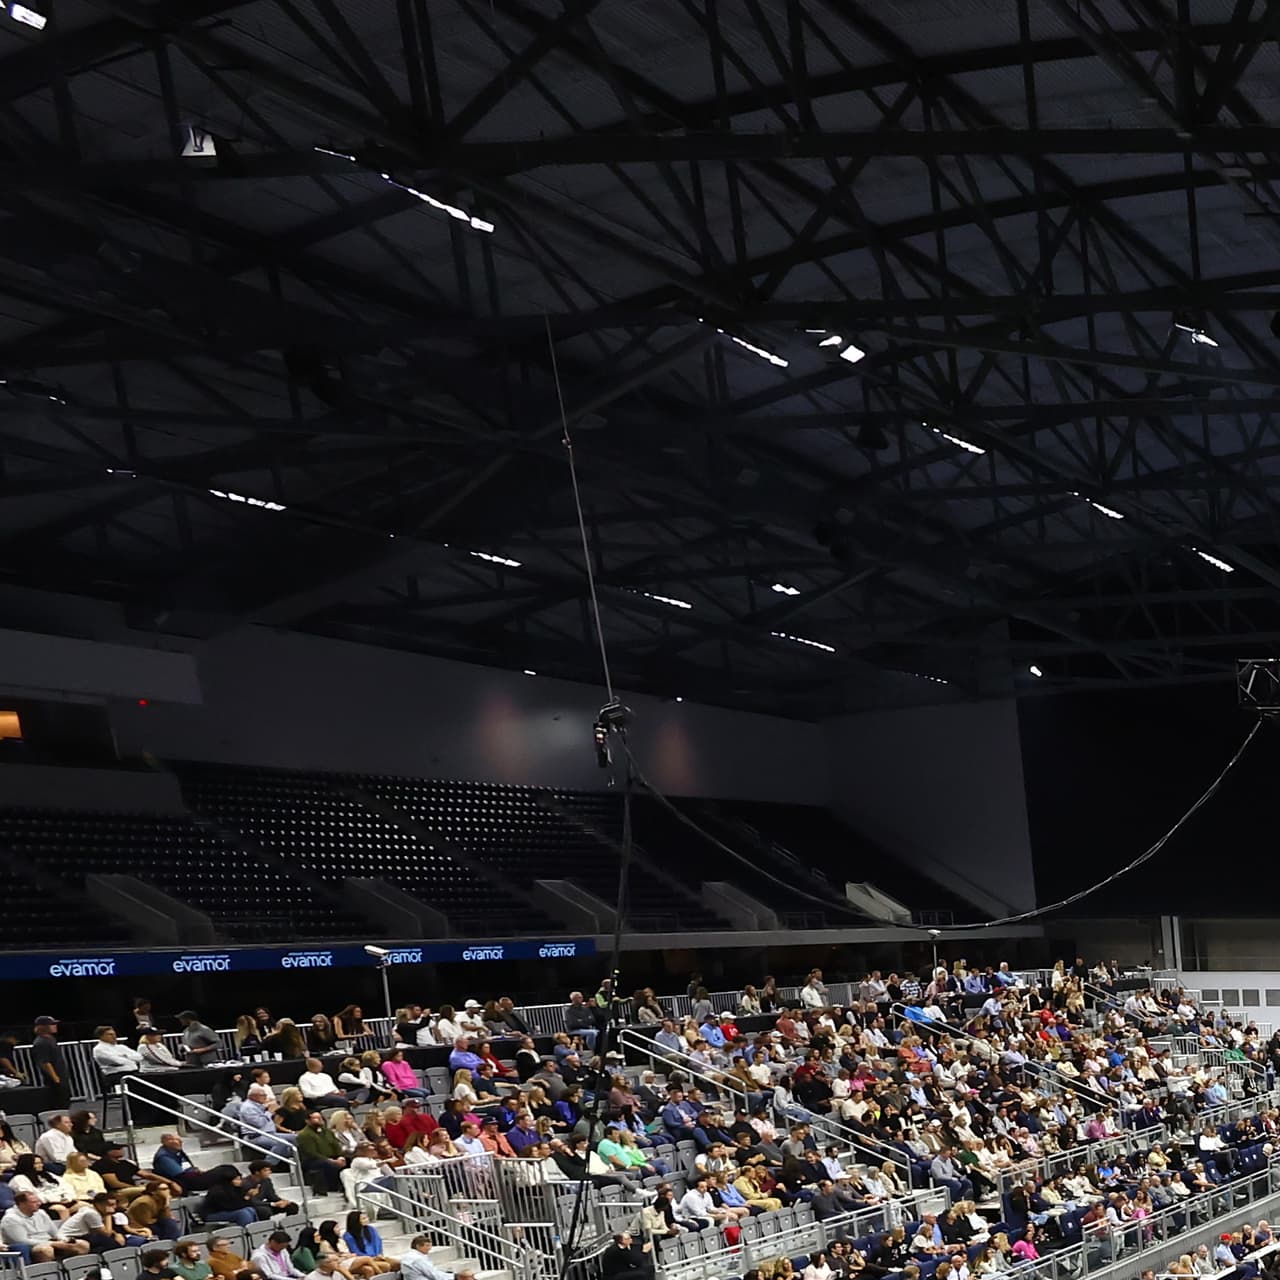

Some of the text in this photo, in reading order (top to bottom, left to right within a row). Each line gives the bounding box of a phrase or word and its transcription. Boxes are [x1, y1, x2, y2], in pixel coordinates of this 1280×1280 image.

[384, 951, 423, 965] vamor
[463, 949, 505, 960] evamor
[538, 946, 576, 958] evamor
[172, 958, 231, 972] evamor
[281, 955, 333, 968] evamor
[50, 962, 116, 977] evamor
